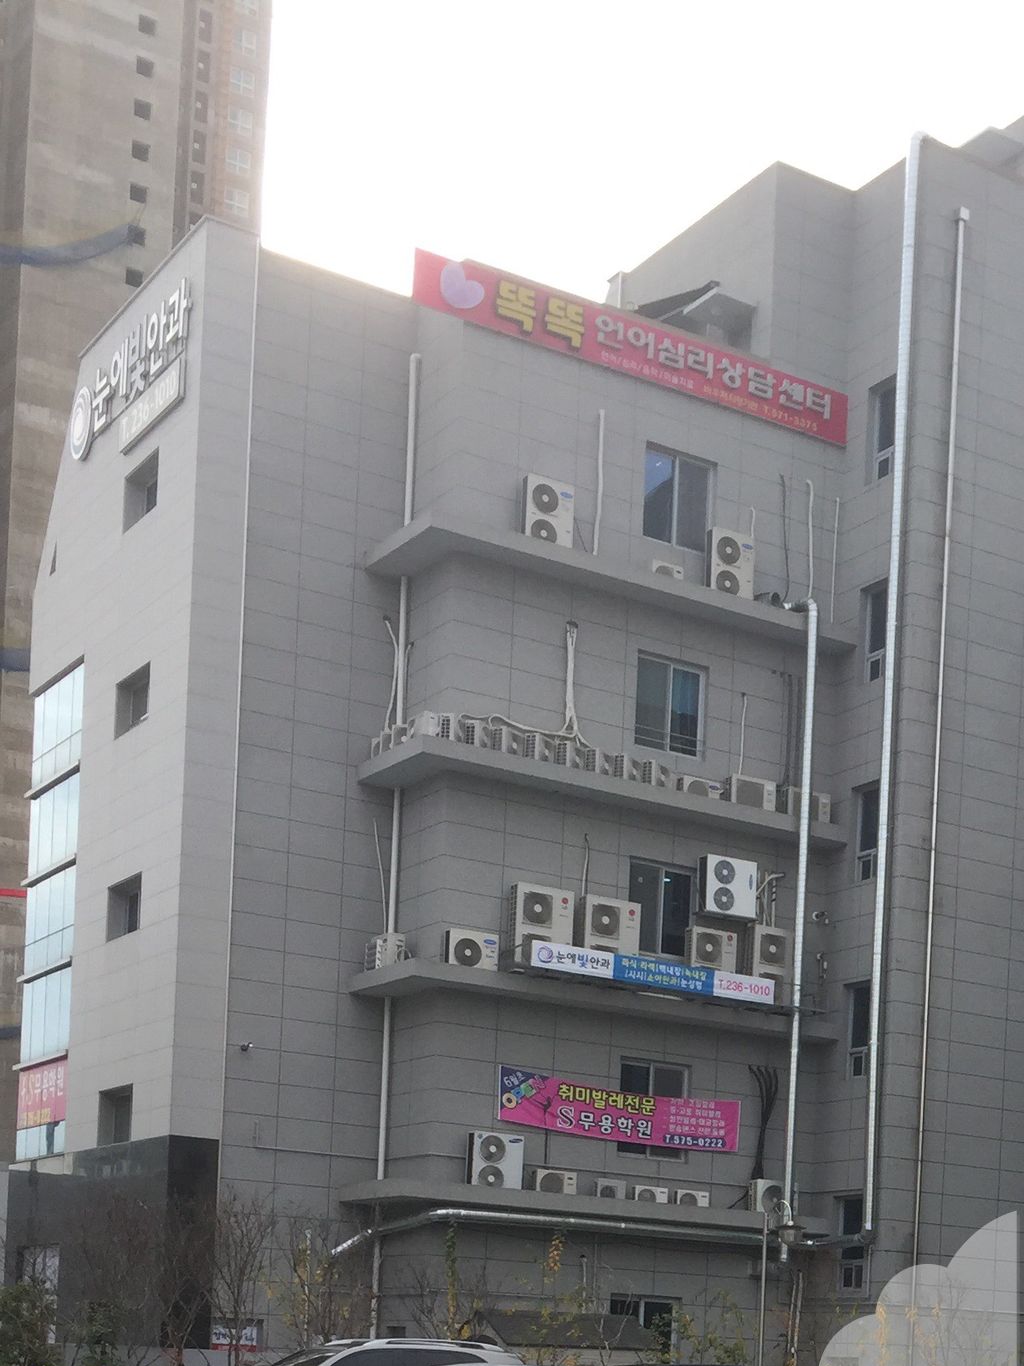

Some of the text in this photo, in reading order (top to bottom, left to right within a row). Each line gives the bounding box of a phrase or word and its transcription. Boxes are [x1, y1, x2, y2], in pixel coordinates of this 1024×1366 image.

[93, 277, 189, 433] 눈에빛안과
[595, 315, 831, 420] 언어심리상담센터
[556, 952, 611, 969] 눈에빛안과
[718, 979, 770, 997] T.236-1010
[558, 1083, 657, 1116] 취미발레전문
[665, 1134, 723, 1147] T.575-0222
